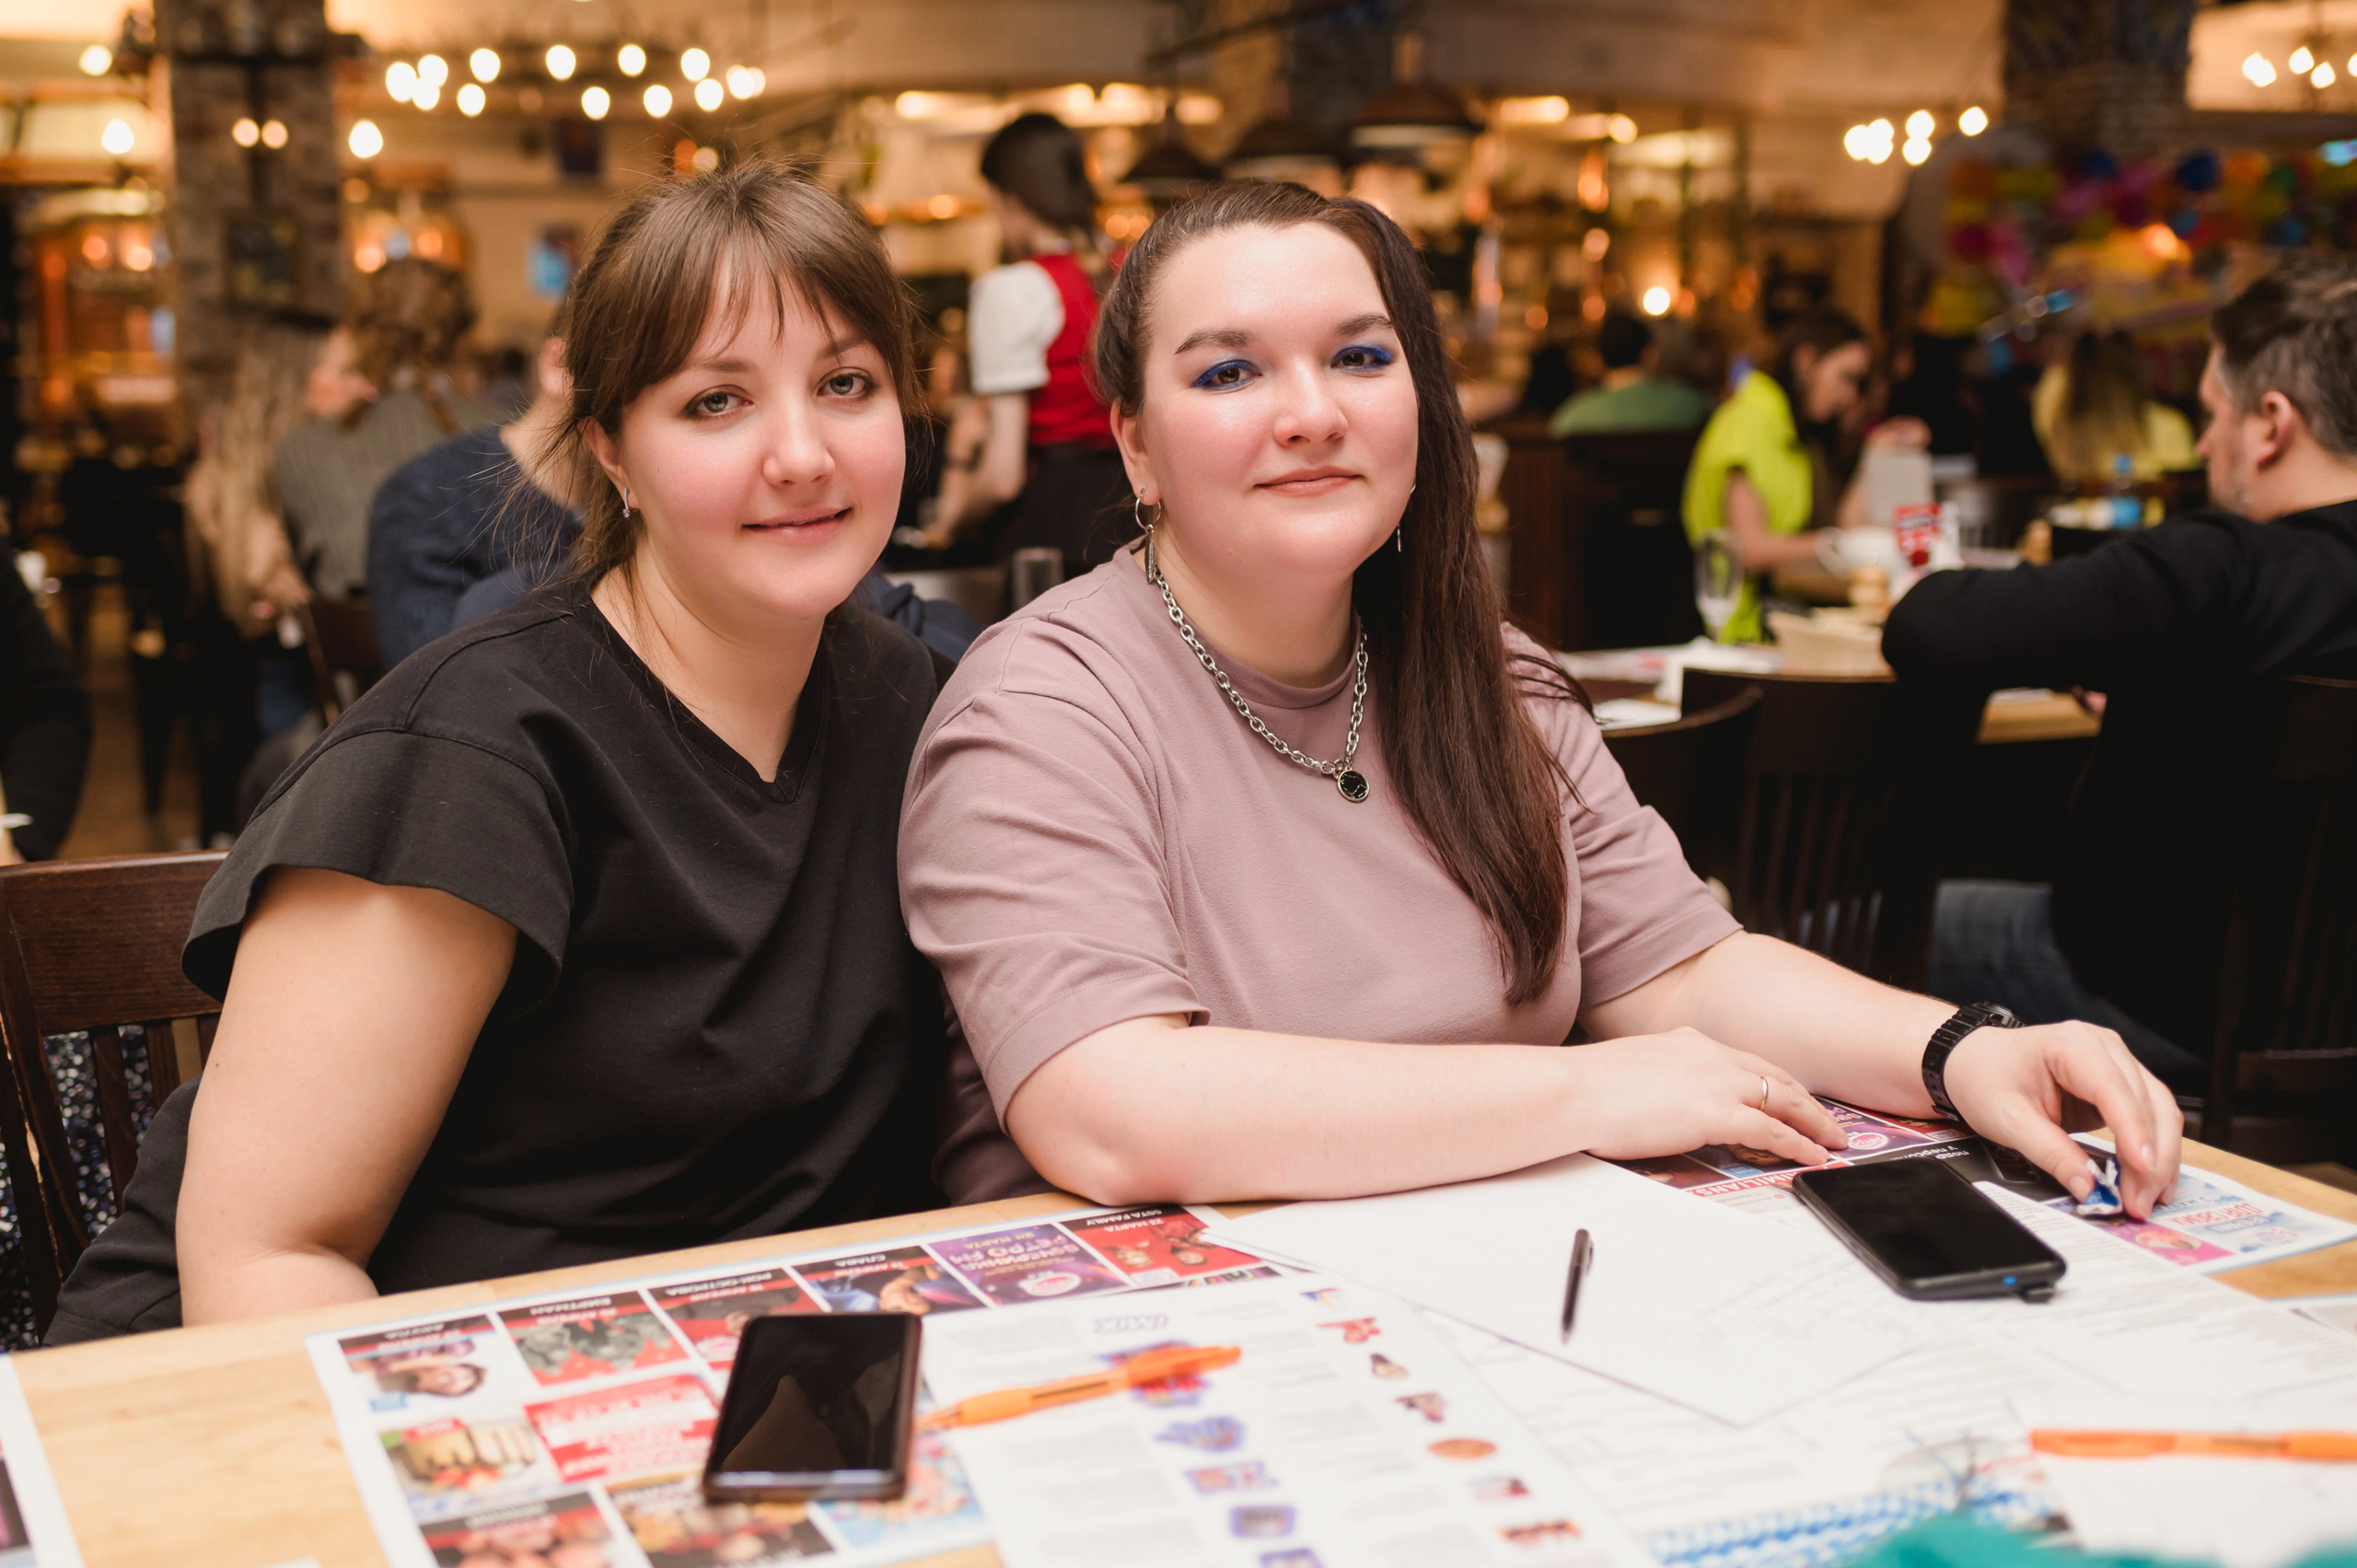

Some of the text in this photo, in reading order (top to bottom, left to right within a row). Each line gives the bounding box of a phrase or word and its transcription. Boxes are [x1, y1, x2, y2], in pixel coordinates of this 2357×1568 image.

[1086, 1213, 1132, 1226] FAMILY
[1104, 1219, 1149, 1233] МАРТА
[963, 1235, 1012, 1249] МАРТА
[987, 1235, 1069, 1258] РЕТРО
[834, 1253, 887, 1268] СЛАВА
[834, 1263, 888, 1278] АПРЕЛЯ
[664, 1272, 773, 1297] РОК-ОСТРОВА
